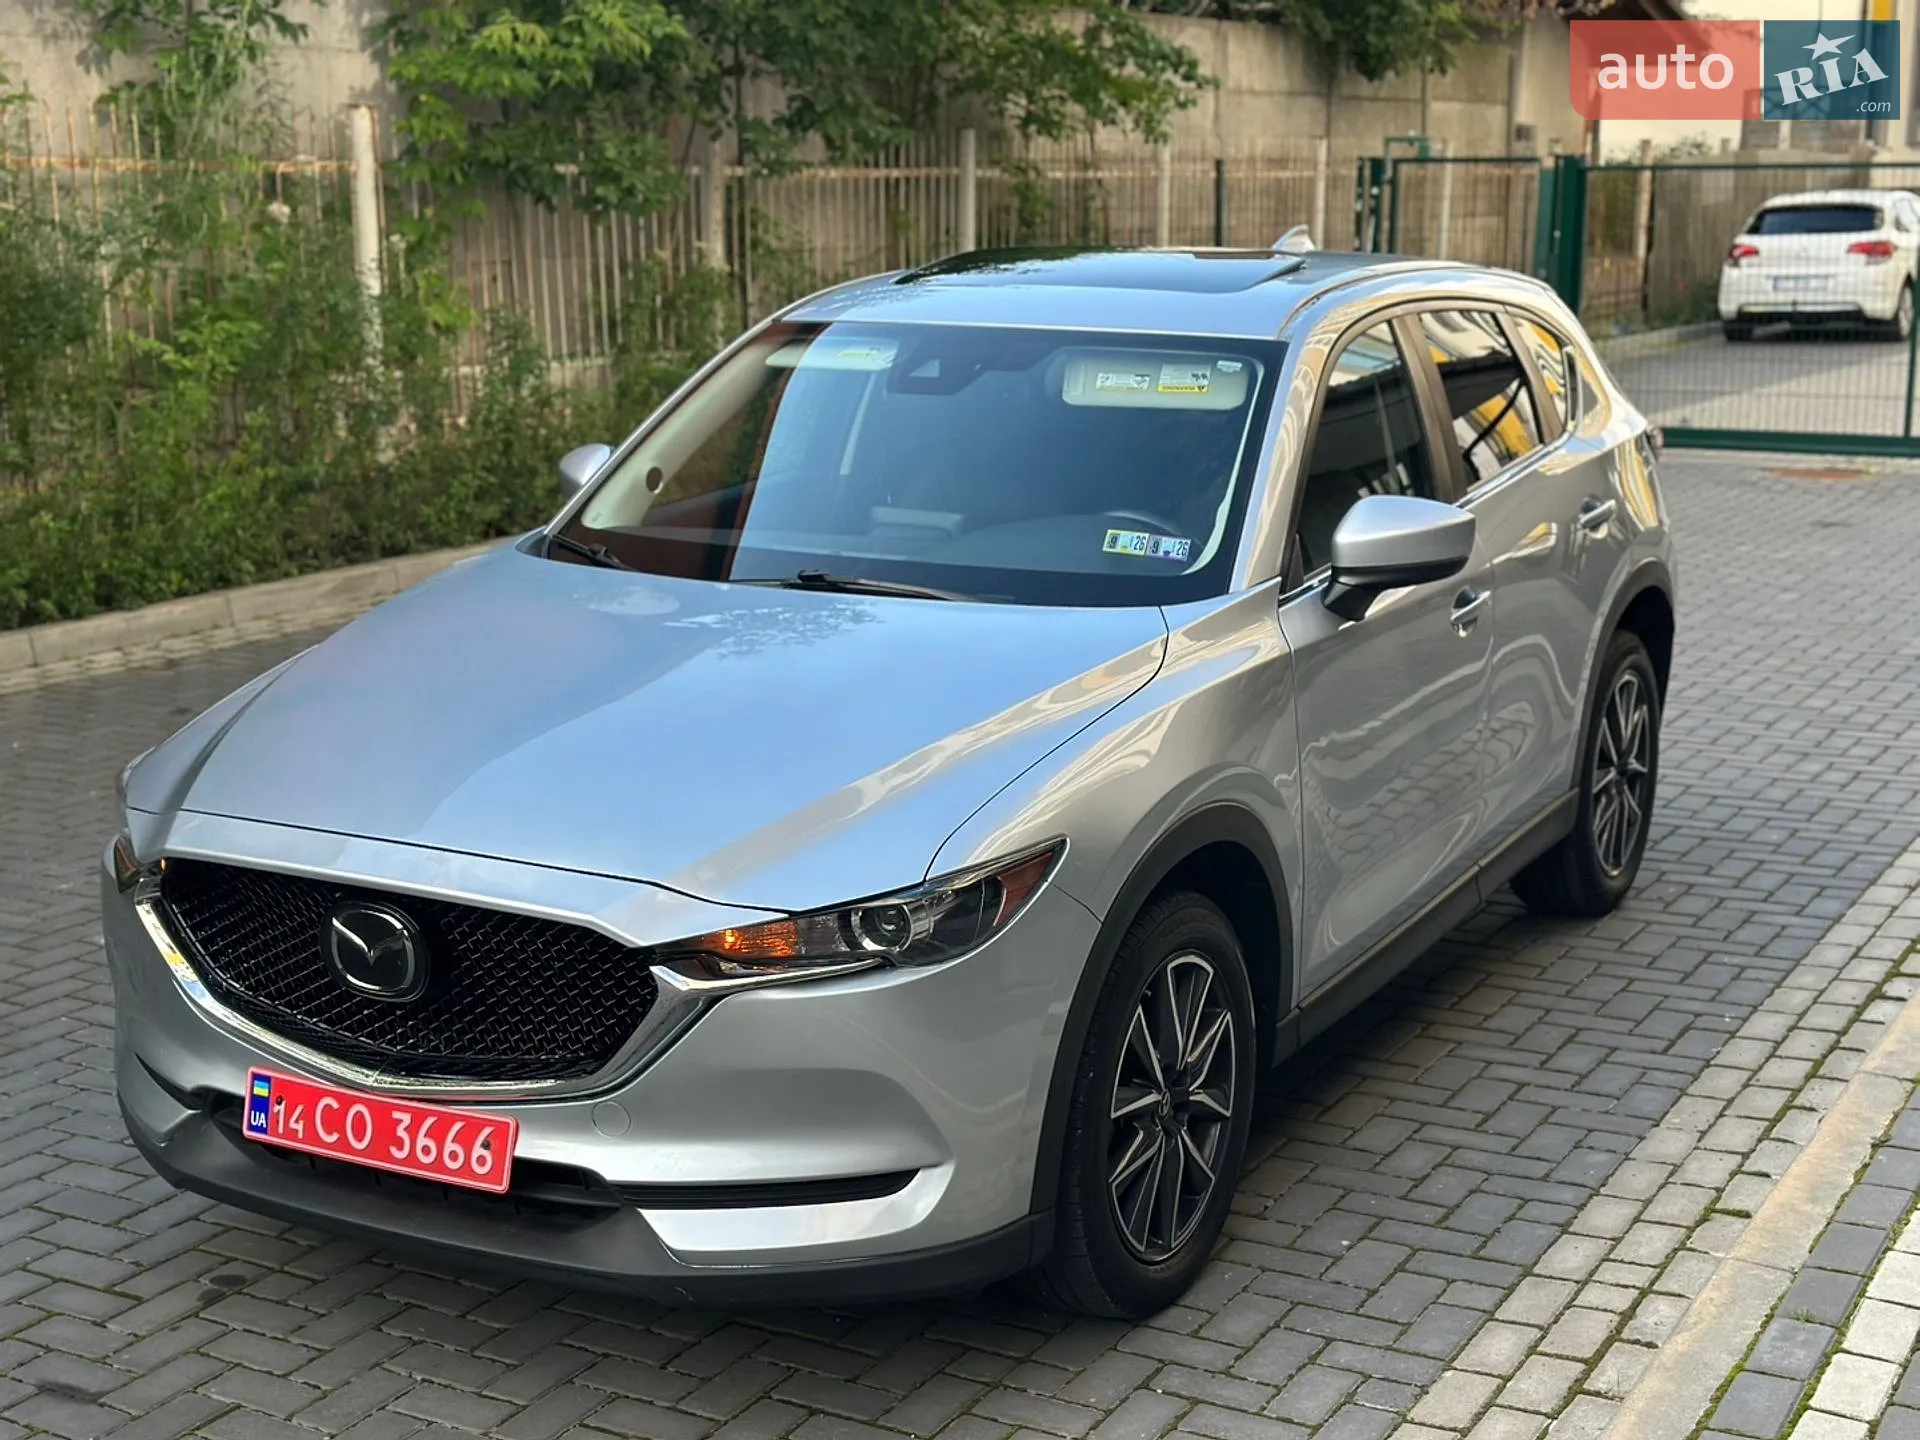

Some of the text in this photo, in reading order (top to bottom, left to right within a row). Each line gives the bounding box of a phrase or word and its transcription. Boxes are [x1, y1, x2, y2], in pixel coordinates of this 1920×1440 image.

[250, 1110, 267, 1128] UA
[273, 1096, 497, 1175] 14 CO 3666
